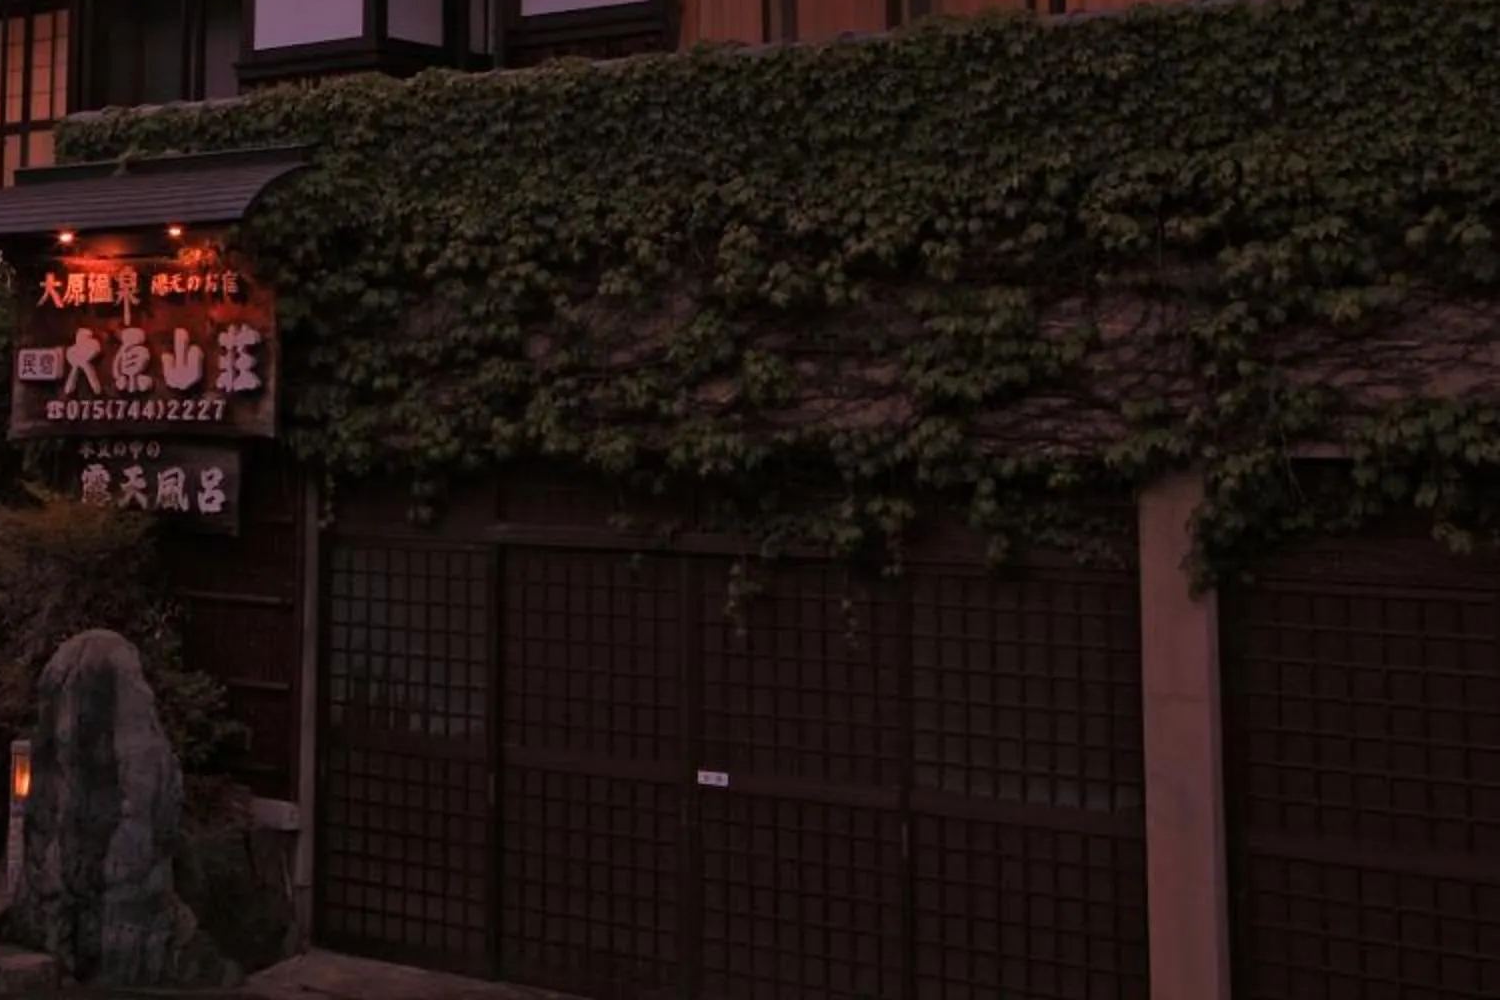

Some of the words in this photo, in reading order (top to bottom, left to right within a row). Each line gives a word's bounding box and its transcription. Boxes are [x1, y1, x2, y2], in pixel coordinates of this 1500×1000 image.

[36, 267, 140, 326] 大原温泉
[64, 325, 262, 394] 大原山荘
[66, 399, 227, 422] 075(744)2227
[80, 463, 226, 514] 露天風呂
